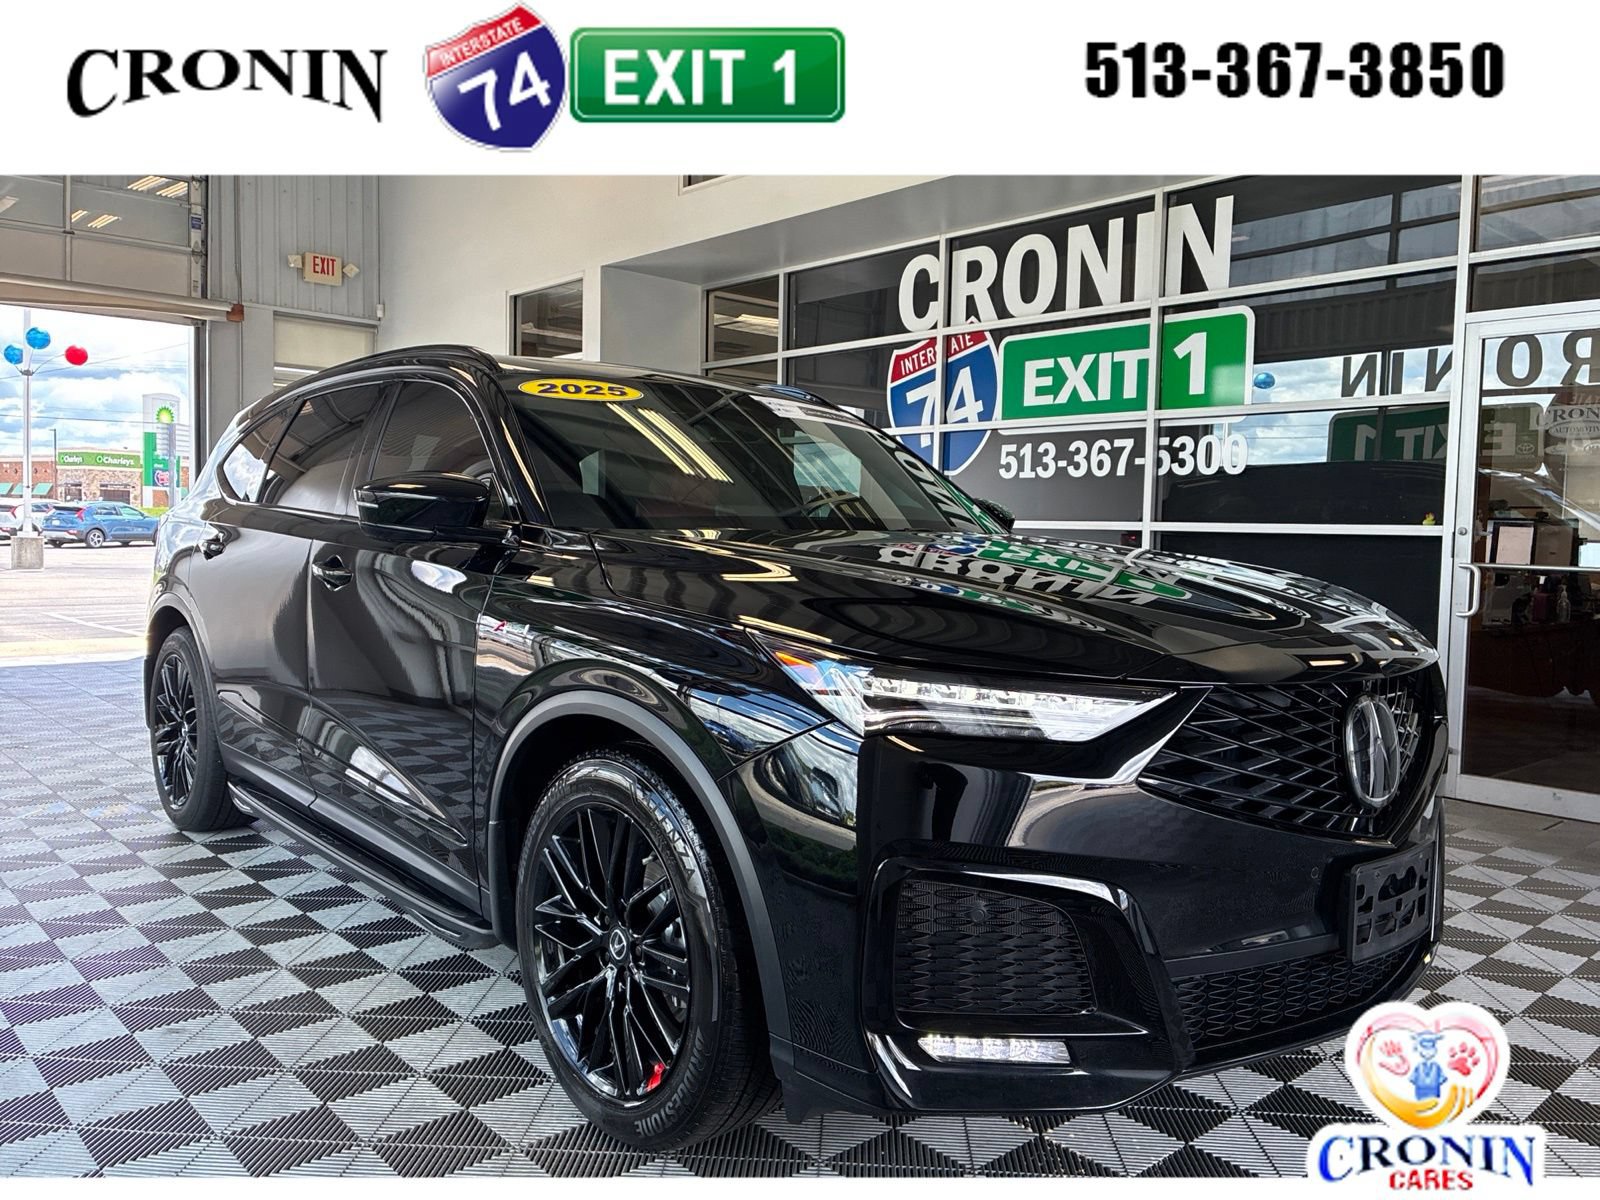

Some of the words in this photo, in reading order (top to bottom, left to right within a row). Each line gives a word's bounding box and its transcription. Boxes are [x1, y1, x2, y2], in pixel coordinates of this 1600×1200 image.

[312, 255, 337, 276] EXIT
[899, 195, 1234, 333] CRONIN
[901, 333, 974, 376] INTERATE
[1023, 347, 1152, 407] EXIT
[1173, 331, 1207, 396] 1
[537, 383, 628, 397] 2025
[906, 366, 984, 448] 74
[999, 434, 1249, 479] 513-367-5300
